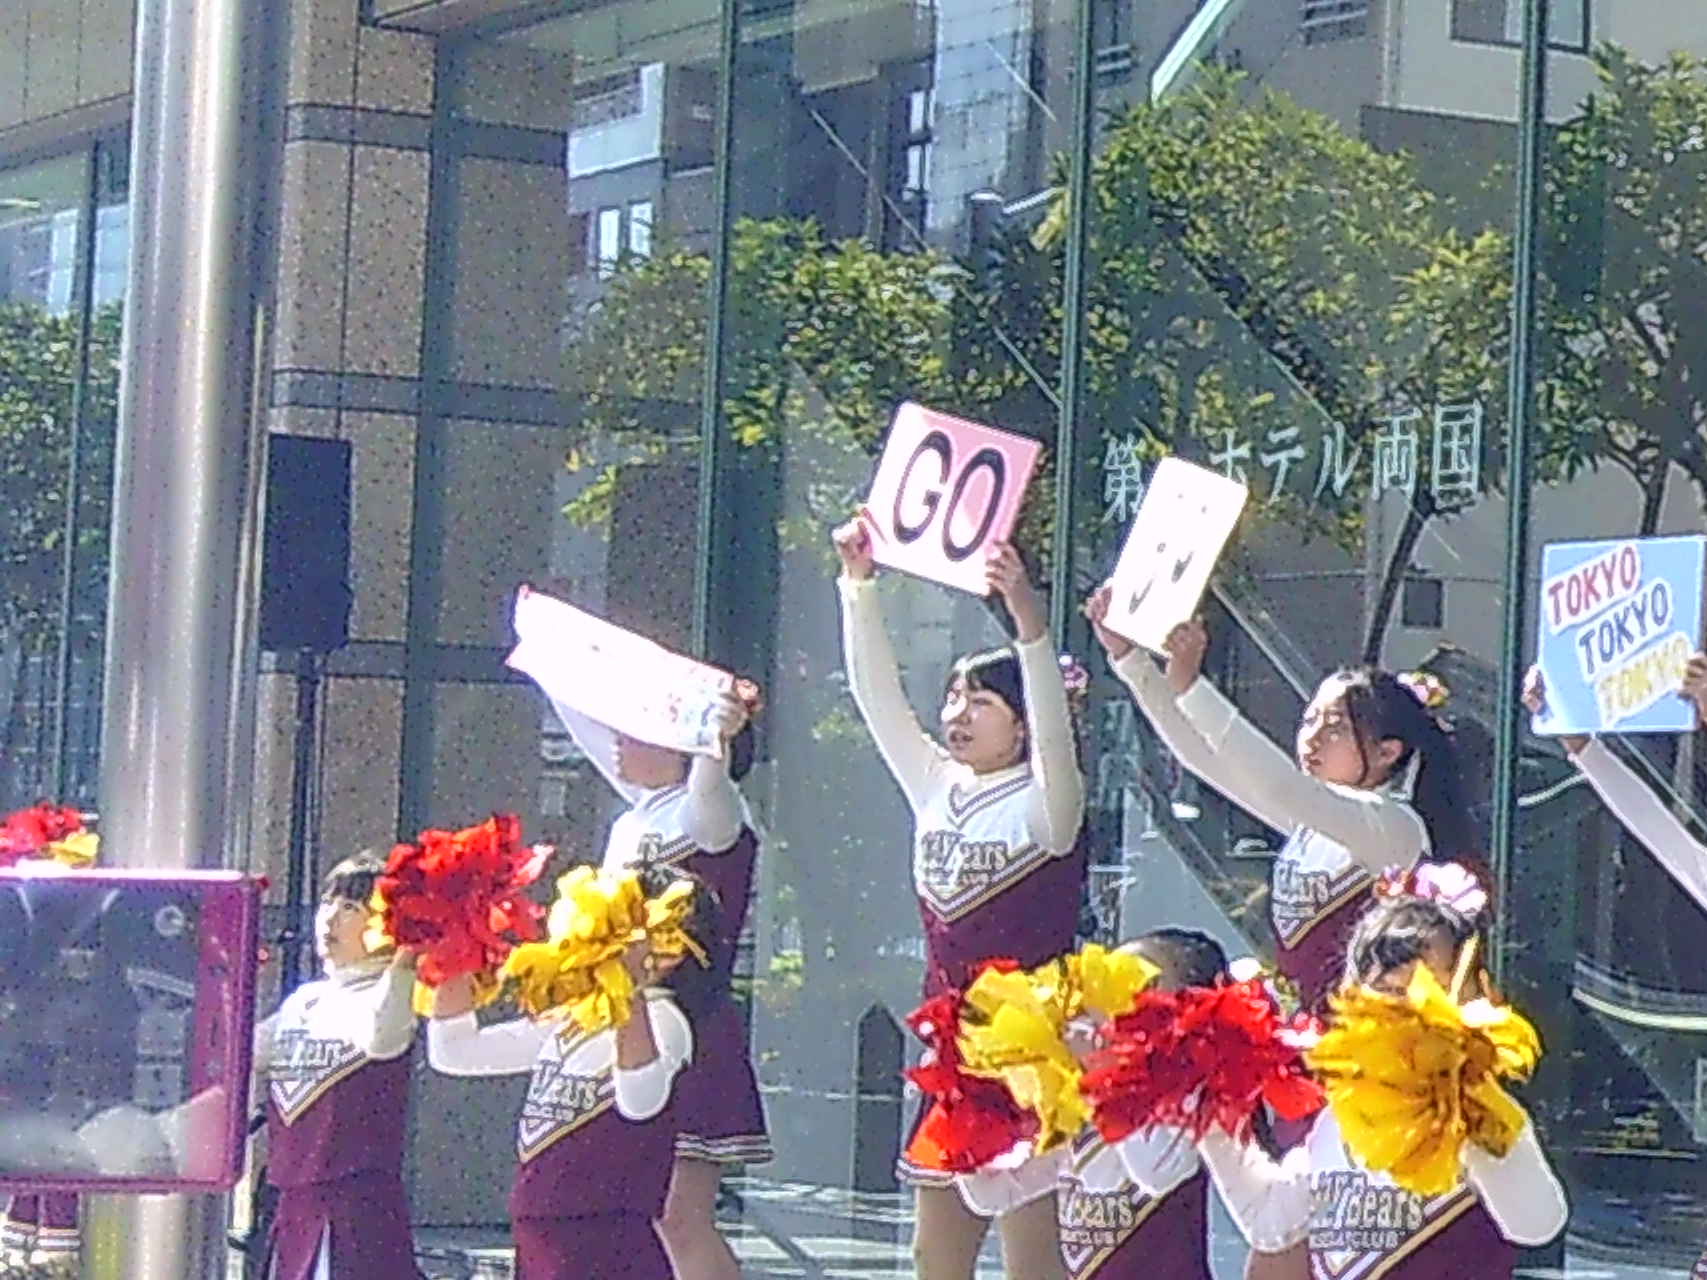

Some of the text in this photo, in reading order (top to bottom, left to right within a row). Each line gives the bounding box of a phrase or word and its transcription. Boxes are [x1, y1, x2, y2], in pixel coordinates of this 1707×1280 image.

[893, 429, 1005, 562] GO
[1104, 398, 1484, 523] 第ホテル両国
[1548, 545, 1637, 626] TOKYO
[1579, 582, 1669, 675] TOKYO
[1600, 636, 1690, 723] TOKYO
